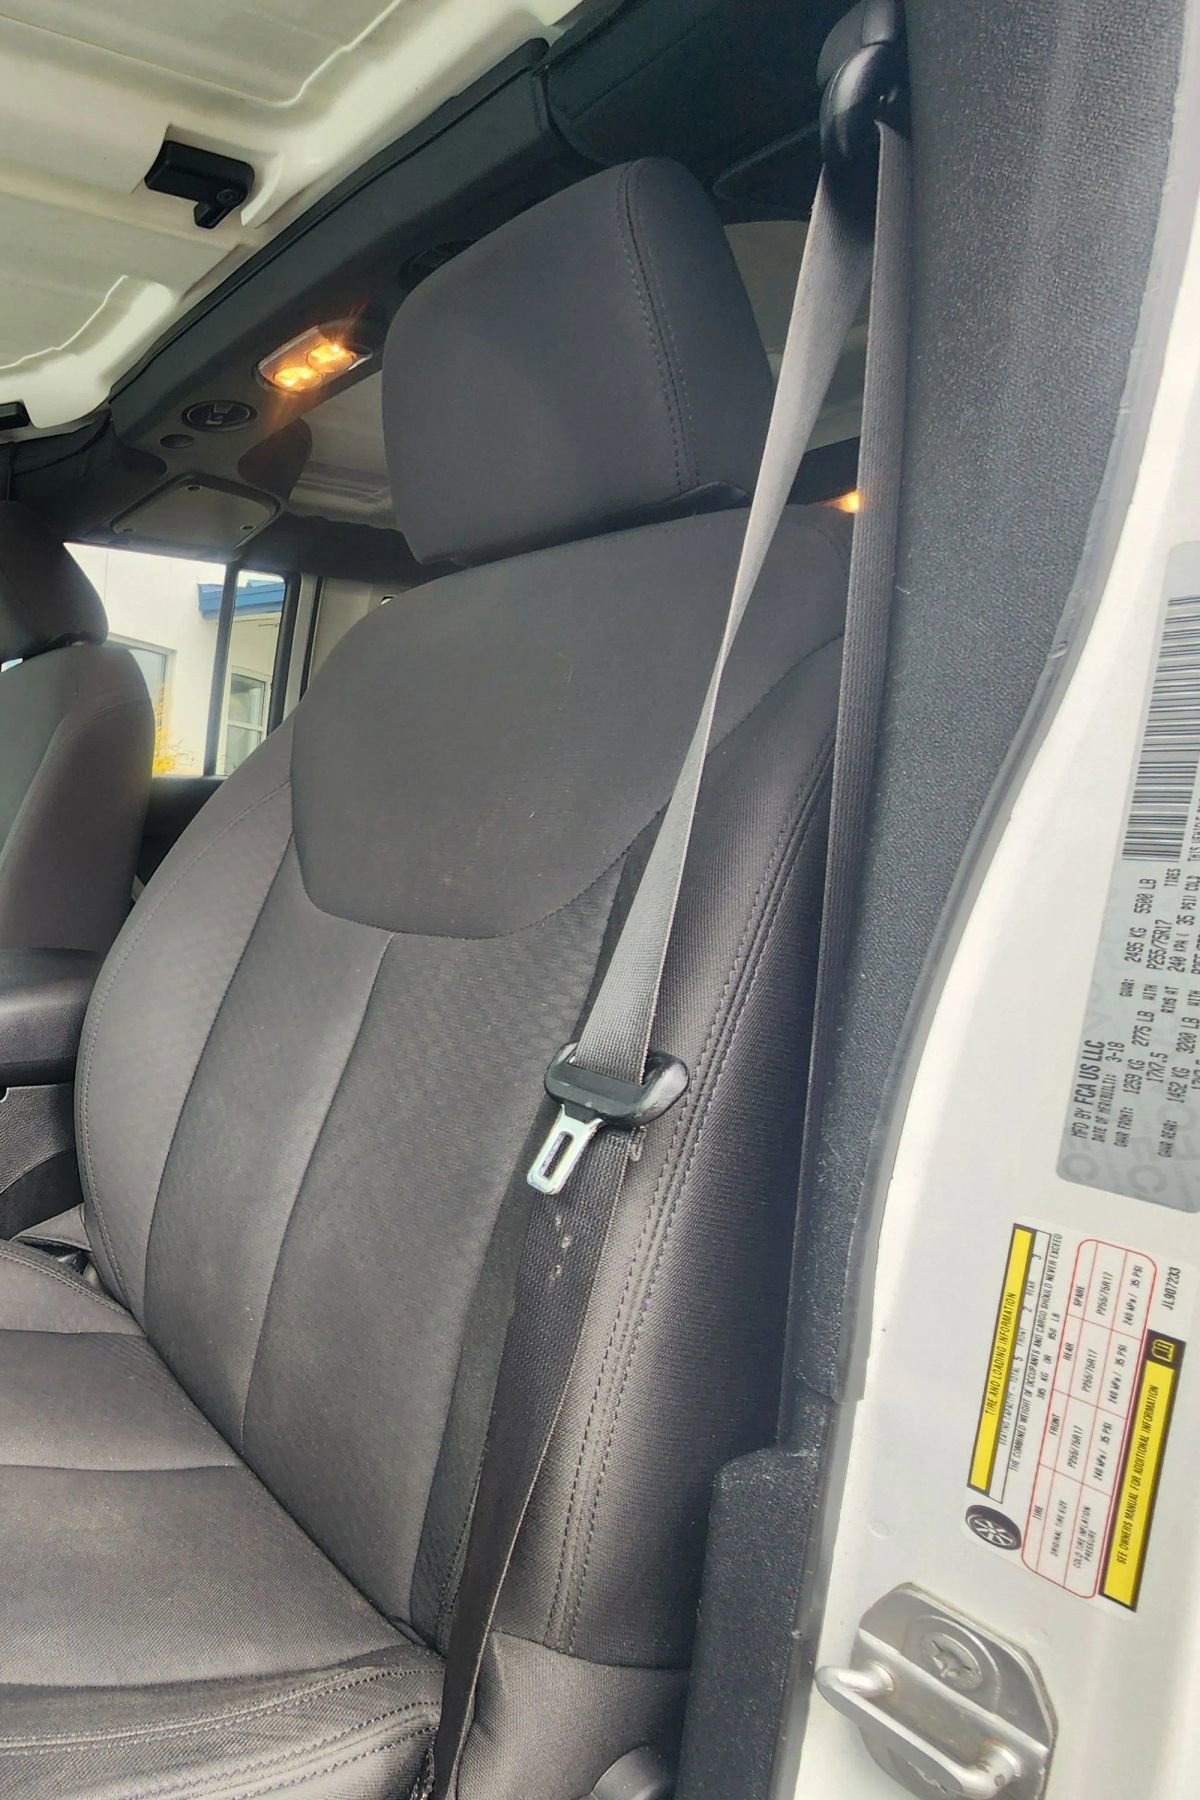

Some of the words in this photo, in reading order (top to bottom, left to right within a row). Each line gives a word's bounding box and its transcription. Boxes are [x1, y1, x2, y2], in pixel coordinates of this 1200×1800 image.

[1138, 879, 1156, 889] LB
[1163, 868, 1181, 887] TIRES
[1133, 894, 1154, 914] 5500
[1176, 915, 1195, 926] 35
[1128, 927, 1147, 938] KG
[1124, 942, 1144, 962] 2495
[1144, 920, 1172, 970] P255/75R17
[1167, 956, 1187, 972] 240
[1142, 984, 1158, 1000] WITH
[1136, 1011, 1155, 1022] LB
[1180, 1017, 1200, 1029] LB
[1131, 1025, 1152, 1047] 2775
[1176, 1032, 1197, 1053] 3200
[1082, 1040, 1105, 1062] LLC
[1105, 1041, 1124, 1062] 3-18
[1078, 1064, 1100, 1080] US
[1126, 1059, 1145, 1071] KG
[1146, 1052, 1168, 1083] 17X7.5
[1171, 1067, 1190, 1079] KG
[1122, 1074, 1142, 1094] 1259
[1166, 1082, 1187, 1103] 1452
[1074, 1084, 1096, 1105] FCA
[1074, 1108, 1092, 1119] BY
[1096, 1116, 1109, 1124] OF
[1072, 1122, 1089, 1138] MFD
[1092, 1128, 1107, 1142] DATE
[1051, 1233, 1062, 1258] EXCEED
[1046, 1260, 1057, 1282] NEVER
[1132, 1265, 1143, 1277] PSI
[1130, 1279, 1140, 1288] 35
[1161, 1267, 1181, 1310] JL907233
[1041, 1283, 1052, 1309] SHOULD
[997, 1293, 1016, 1344] INFORMATION
[1036, 1311, 1047, 1333] CARGO
[1034, 1334, 1042, 1348] AND
[1115, 1344, 1127, 1356] PSI
[992, 1347, 1007, 1379] LOADING
[1026, 1350, 1040, 1387] OCCUPANTS
[1043, 1355, 1052, 1364] OR
[1114, 1358, 1124, 1367] 35
[1041, 1372, 1048, 1382] KG
[1067, 1425, 1084, 1468] P255/75R17
[1082, 1349, 1097, 1392] P255/75R17
[1096, 1272, 1113, 1315] P255/75R17
[989, 1381, 1000, 1397] AND
[1024, 1389, 1033, 1397] OF
[985, 1399, 997, 1415] TIRE
[1019, 1399, 1032, 1423] WEIGHT
[1033, 1505, 1043, 1520] TIRE
[1049, 1413, 1060, 1435] FRONT
[1063, 1342, 1074, 1360] REAR
[1073, 1285, 1085, 1307] SPARE
[1137, 1384, 1159, 1433] INFORMATION
[1102, 1423, 1112, 1435] PSI
[1012, 1425, 1026, 1458] COMBINED
[1131, 1435, 1149, 1475] ADDITIONAL
[1010, 1459, 1020, 1472] THE
[1128, 1475, 1140, 1490] FOR
[1123, 1493, 1138, 1521] MANUAL
[1084, 1529, 1097, 1562] PRESSURE
[1119, 1522, 1133, 1550] OWNERS
[1116, 1551, 1127, 1564] SEE
